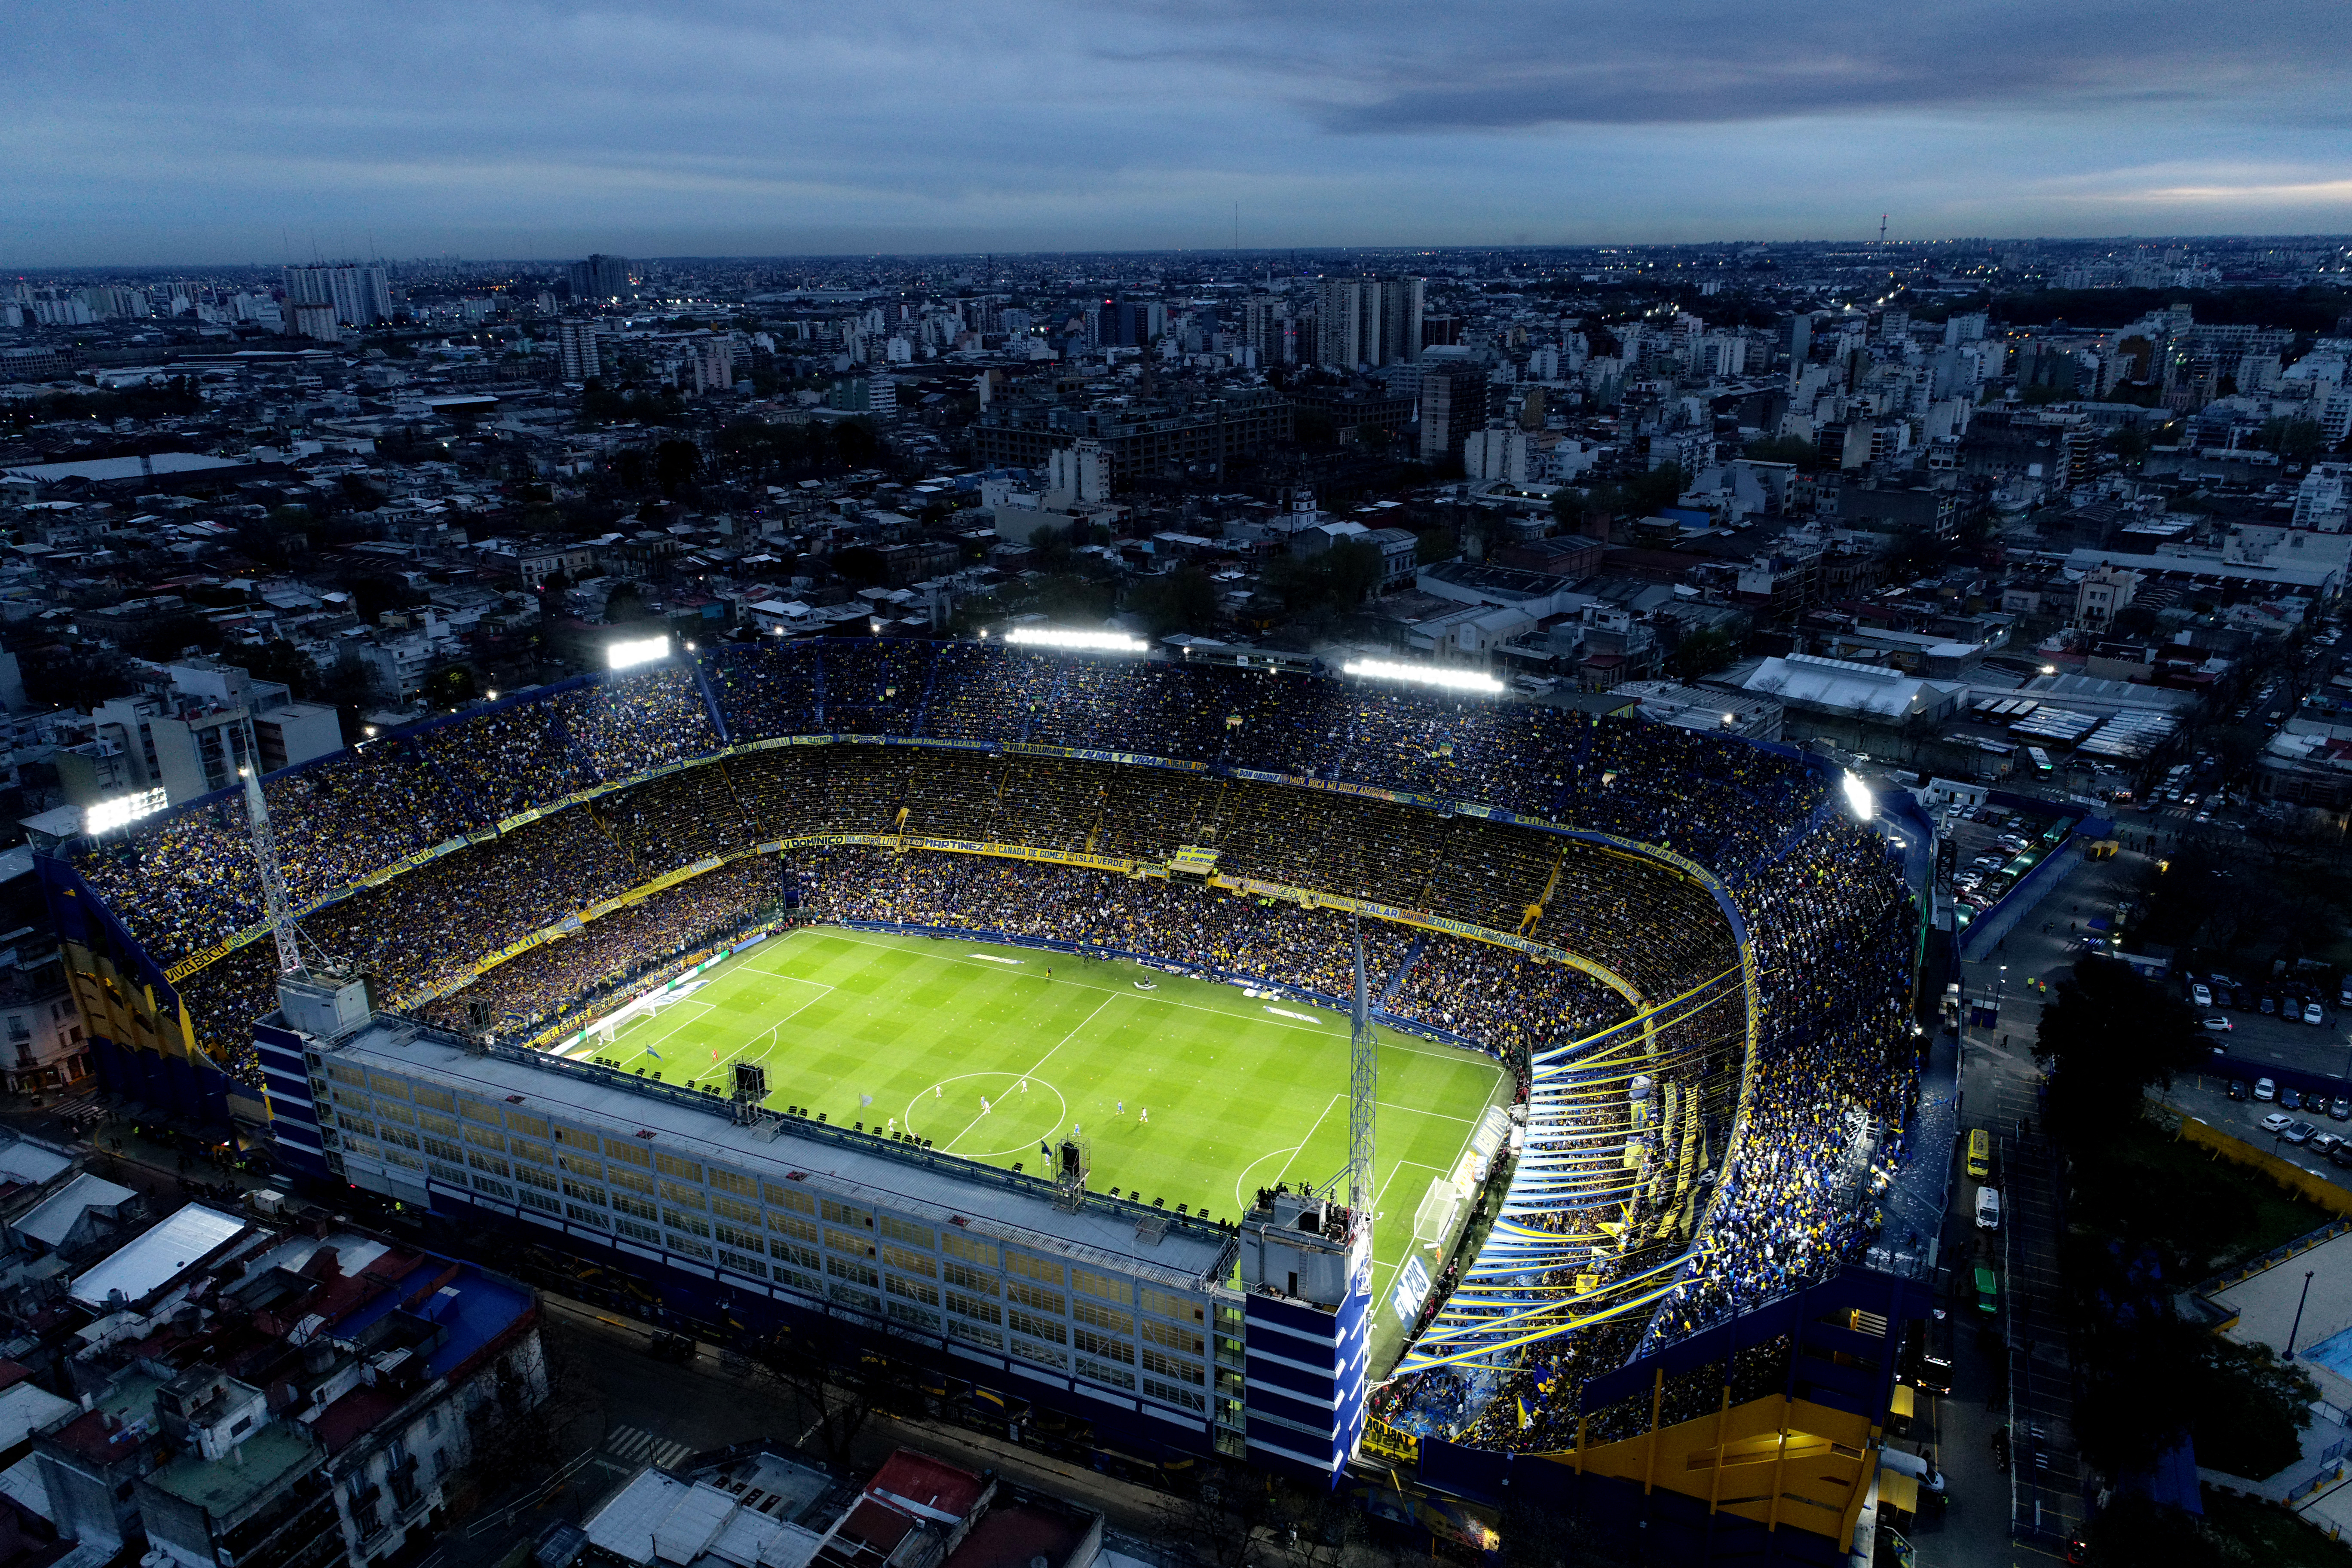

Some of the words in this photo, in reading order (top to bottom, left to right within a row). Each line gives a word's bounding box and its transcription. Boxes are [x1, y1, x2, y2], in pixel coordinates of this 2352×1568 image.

[762, 737, 790, 749] BERNAL
[924, 738, 952, 746] FAMILIA
[1010, 743, 1029, 752] VILLA
[1030, 744, 1038, 753] 20
[1038, 746, 1066, 756] LUGANO
[1083, 750, 1113, 761] ALMA
[1118, 753, 1127, 762] Y
[1132, 755, 1157, 765] VIDA
[1166, 759, 1192, 769] LUGANO
[628, 772, 651, 783] MOV.
[651, 763, 682, 775] PASION
[683, 754, 721, 767] BOQUENS
[1239, 769, 1253, 778] DON
[1254, 772, 1278, 782] ORIONE
[1289, 776, 1306, 786] MOV.
[1308, 779, 1325, 789] BOCA
[1326, 781, 1337, 790] MI
[1338, 783, 1358, 793] BUEN
[1359, 786, 1383, 797] AMIGO
[538, 796, 571, 816] MAGDALENA
[501, 820, 518, 830] VILLA
[863, 836, 897, 846] CABALLITO
[925, 839, 985, 851] MARTINEZ
[410, 849, 432, 864] SAVIO
[723, 851, 745, 864] BOSTERO
[998, 845, 1026, 856] CAÑADA
[1028, 849, 1038, 858] DE
[1040, 850, 1065, 860] GOMEZ
[1195, 848, 1221, 857] ACOSTA
[1645, 845, 1668, 859] VIEJO
[1669, 852, 1688, 868] BOCA
[390, 860, 411, 873] OLIVOS
[689, 858, 718, 873] LANUS
[1075, 854, 1094, 864] ISLA
[1097, 857, 1125, 868] VERDE
[1138, 863, 1164, 871] HUDSON
[654, 872, 677, 886] AGUANTE
[677, 866, 690, 879] BOCA
[1221, 876, 1250, 888] MARCOS
[1251, 882, 1279, 894] JUAREZ
[1278, 886, 1303, 898] GERLI
[1365, 903, 1398, 918] TALAR
[1402, 911, 1427, 923] SAKURA
[229, 935, 245, 948] LOS
[243, 920, 272, 941] HORNOS
[1428, 916, 1482, 937] BERAZATEGUI
[1500, 935, 1525, 950] VARELA
[163, 961, 196, 982] VIVA
[192, 943, 229, 968] BOCA
[435, 963, 477, 992] ANDERSON
[440, 980, 462, 999] GRAND
[614, 980, 649, 1001] PATERNAL
[1743, 962, 1757, 1022] NUMERO
[559, 1018, 576, 1034] ESTO
[579, 1012, 588, 1022] ES
[1685, 1087, 1697, 1138] HINCHADA
